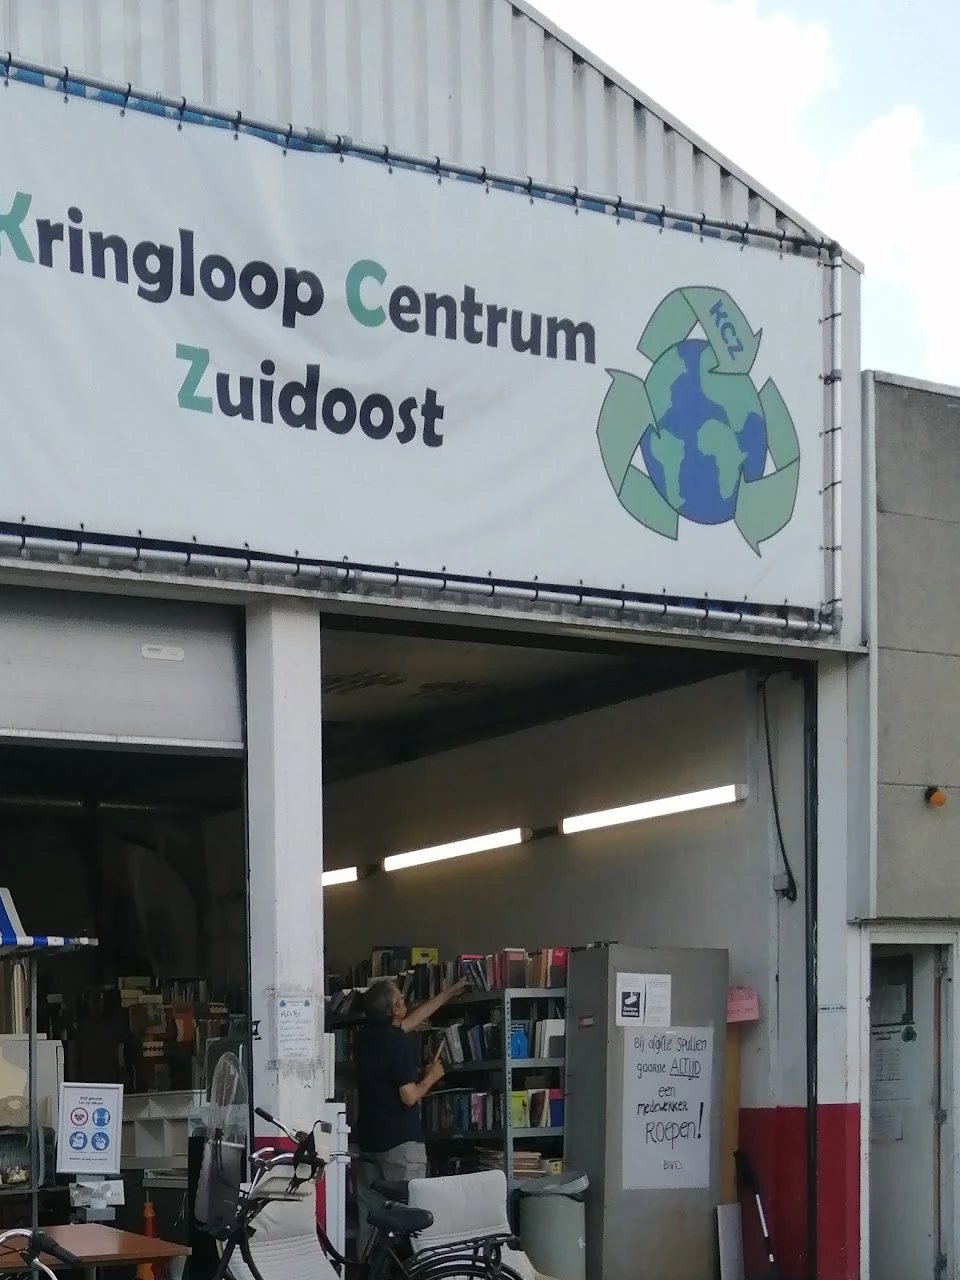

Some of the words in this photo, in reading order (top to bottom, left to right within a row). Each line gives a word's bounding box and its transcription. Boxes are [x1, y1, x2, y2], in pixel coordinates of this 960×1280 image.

[345, 258, 597, 365] Centrum
[709, 299, 744, 362] KCZ
[176, 343, 446, 448] Zuidoost
[634, 1037, 645, 1053] Bij
[658, 1086, 676, 1098] een
